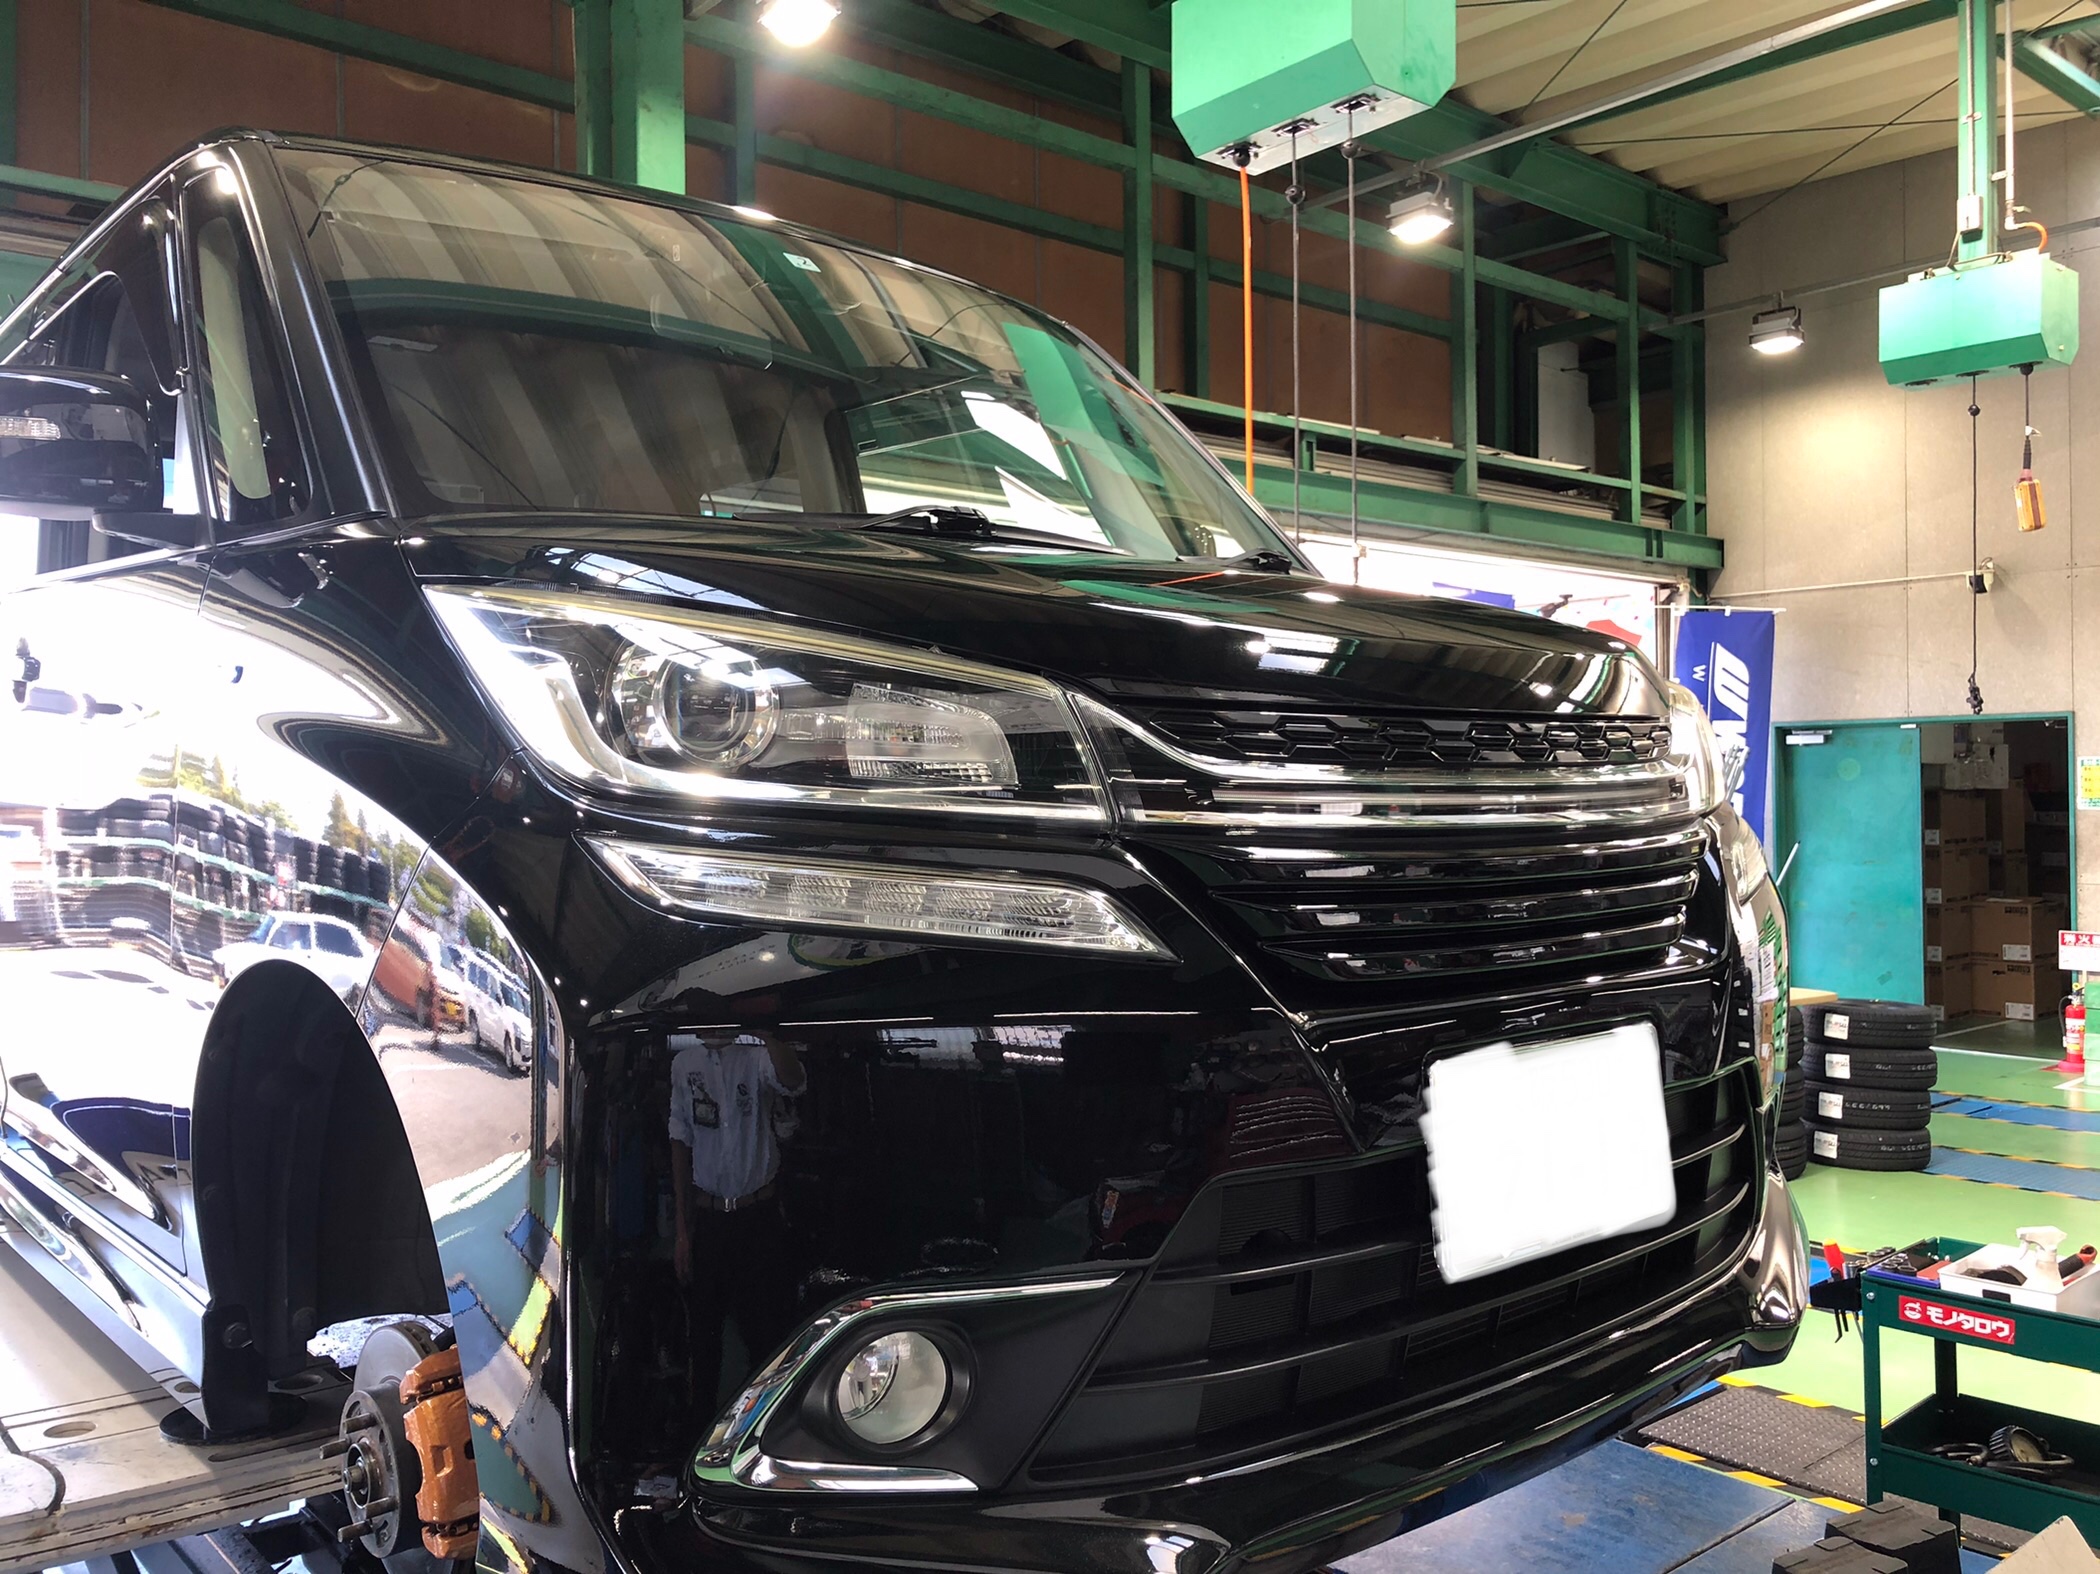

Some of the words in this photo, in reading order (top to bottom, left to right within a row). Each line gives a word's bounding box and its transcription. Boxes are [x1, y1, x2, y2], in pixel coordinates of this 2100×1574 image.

[1926, 1305, 2010, 1338] モノタロウ
